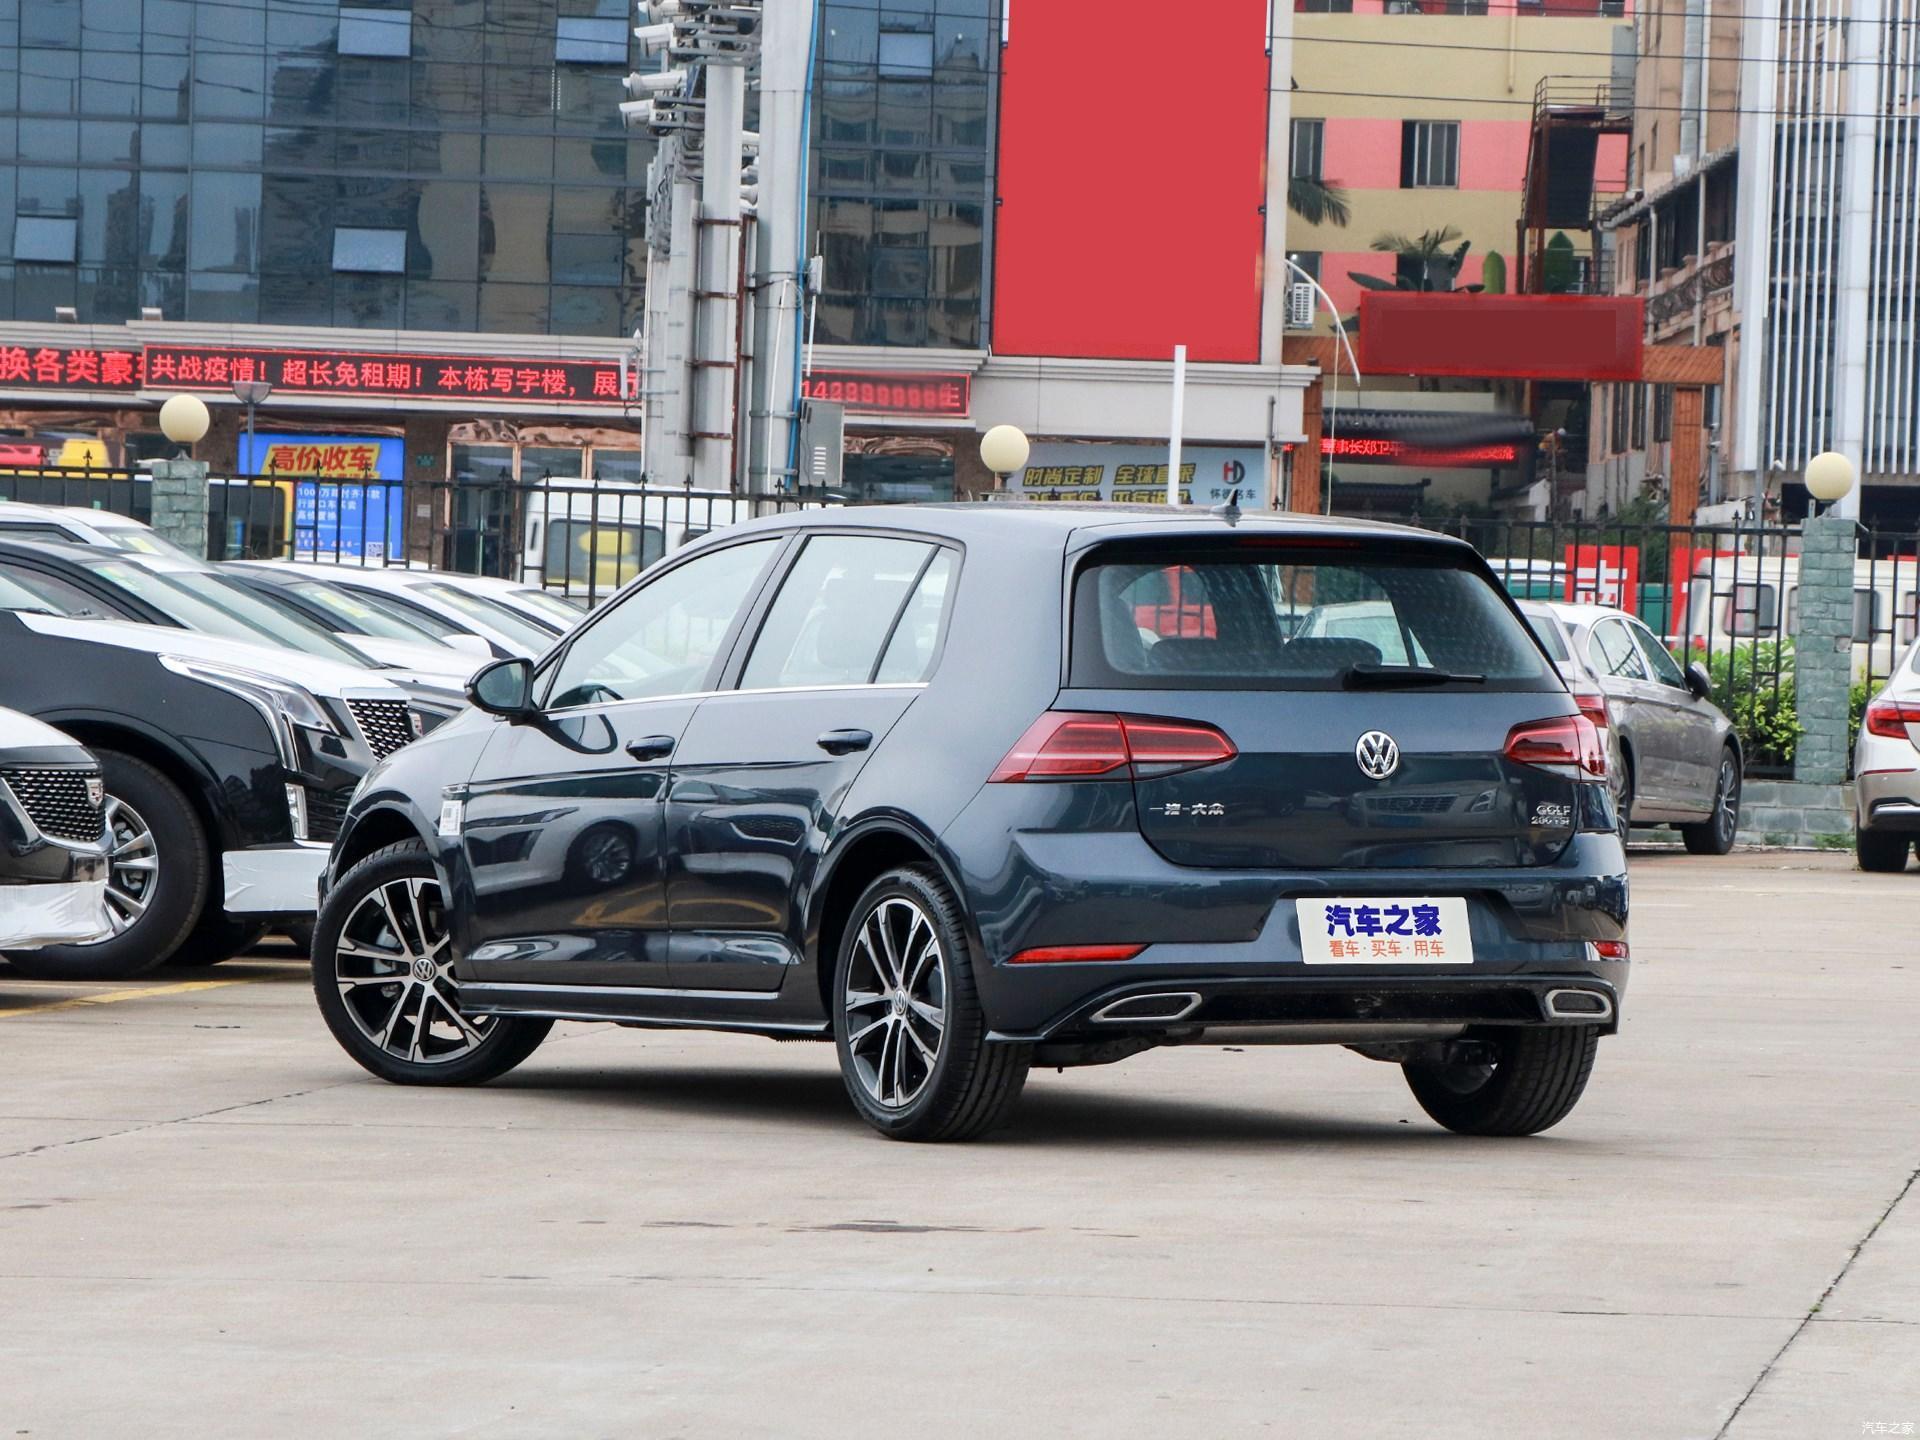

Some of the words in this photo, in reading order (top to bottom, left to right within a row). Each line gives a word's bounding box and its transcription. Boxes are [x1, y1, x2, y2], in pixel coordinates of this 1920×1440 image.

[0, 346, 143, 384] 换各类豪
[271, 446, 375, 471] 高价收车
[1023, 465, 1104, 486] 时尚定制
[1536, 805, 1571, 816] GOLF
[1325, 904, 1442, 937] 汽车之家
